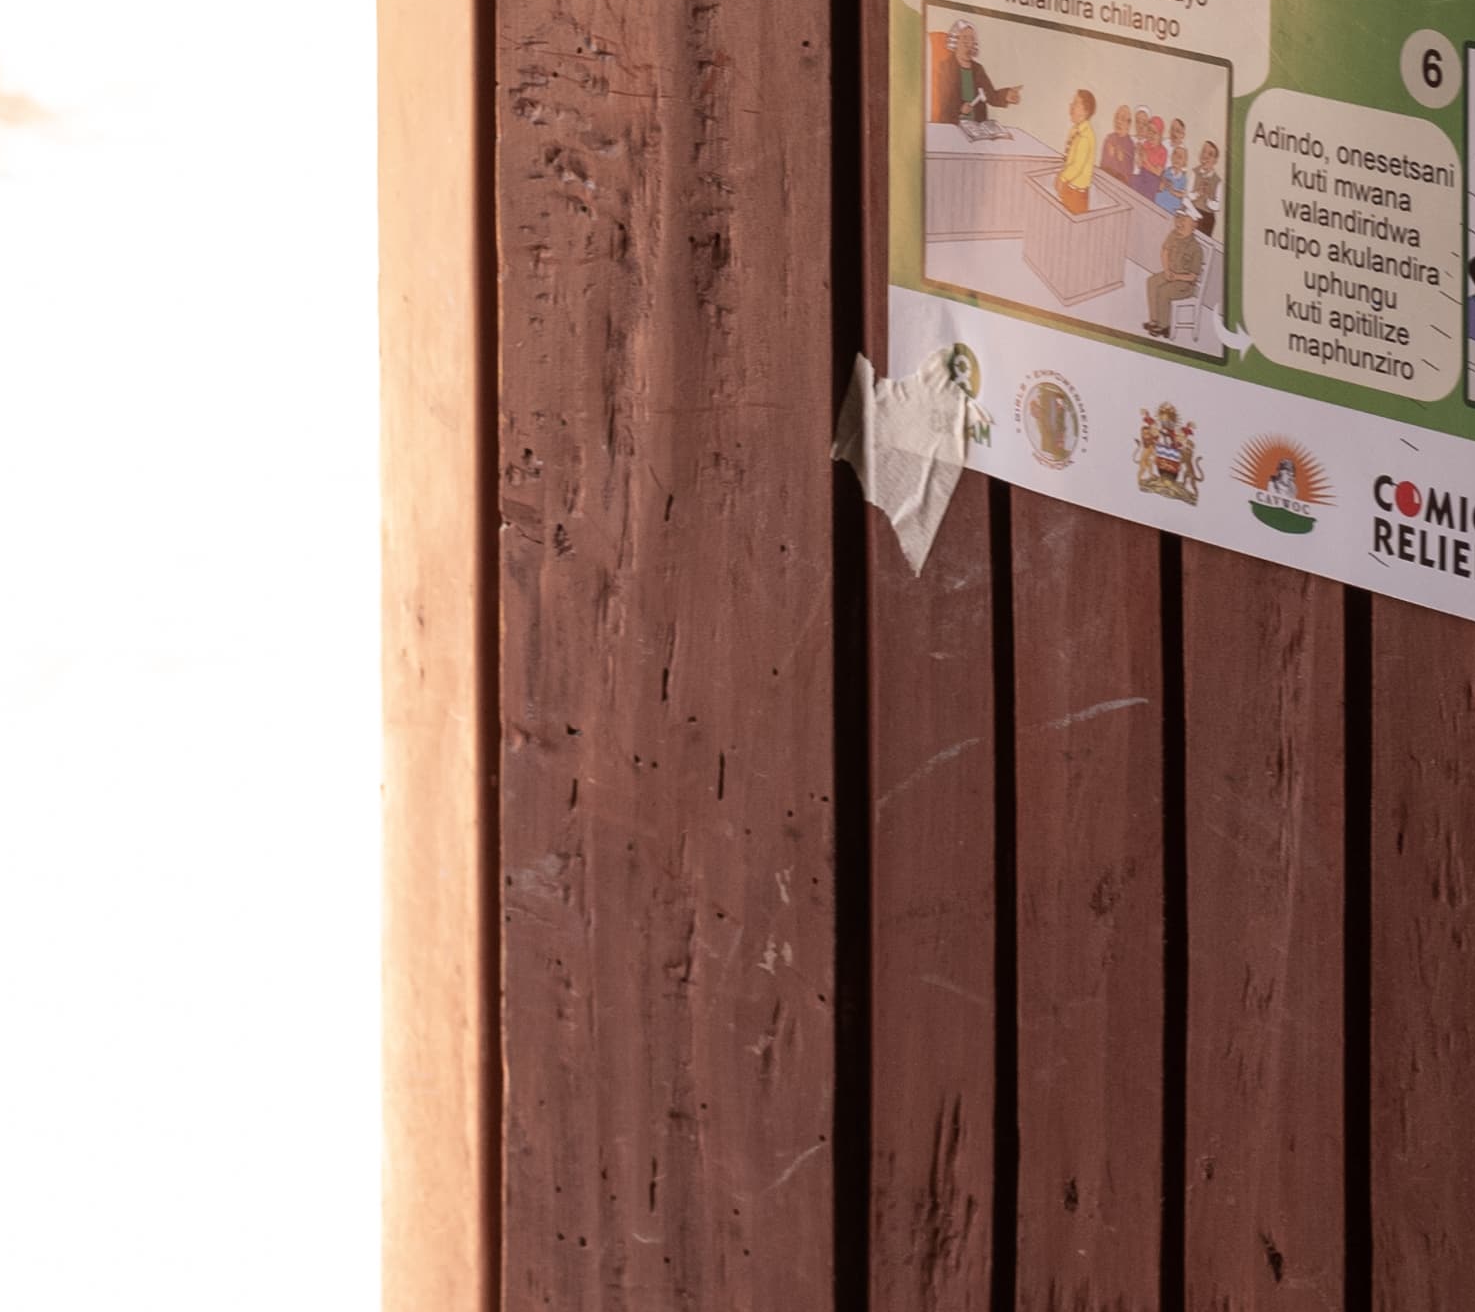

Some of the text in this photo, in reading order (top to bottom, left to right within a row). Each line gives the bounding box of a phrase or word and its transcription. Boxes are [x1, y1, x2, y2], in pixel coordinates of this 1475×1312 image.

[1421, 48, 1444, 88] 6
[1252, 124, 1454, 187] Adindo, onesetsani
[1292, 163, 1411, 212] kuti mwana
[1282, 200, 1420, 247] walandiridwa
[1265, 229, 1440, 285] ndipo akulandira
[1289, 333, 1414, 380] maphunziro
